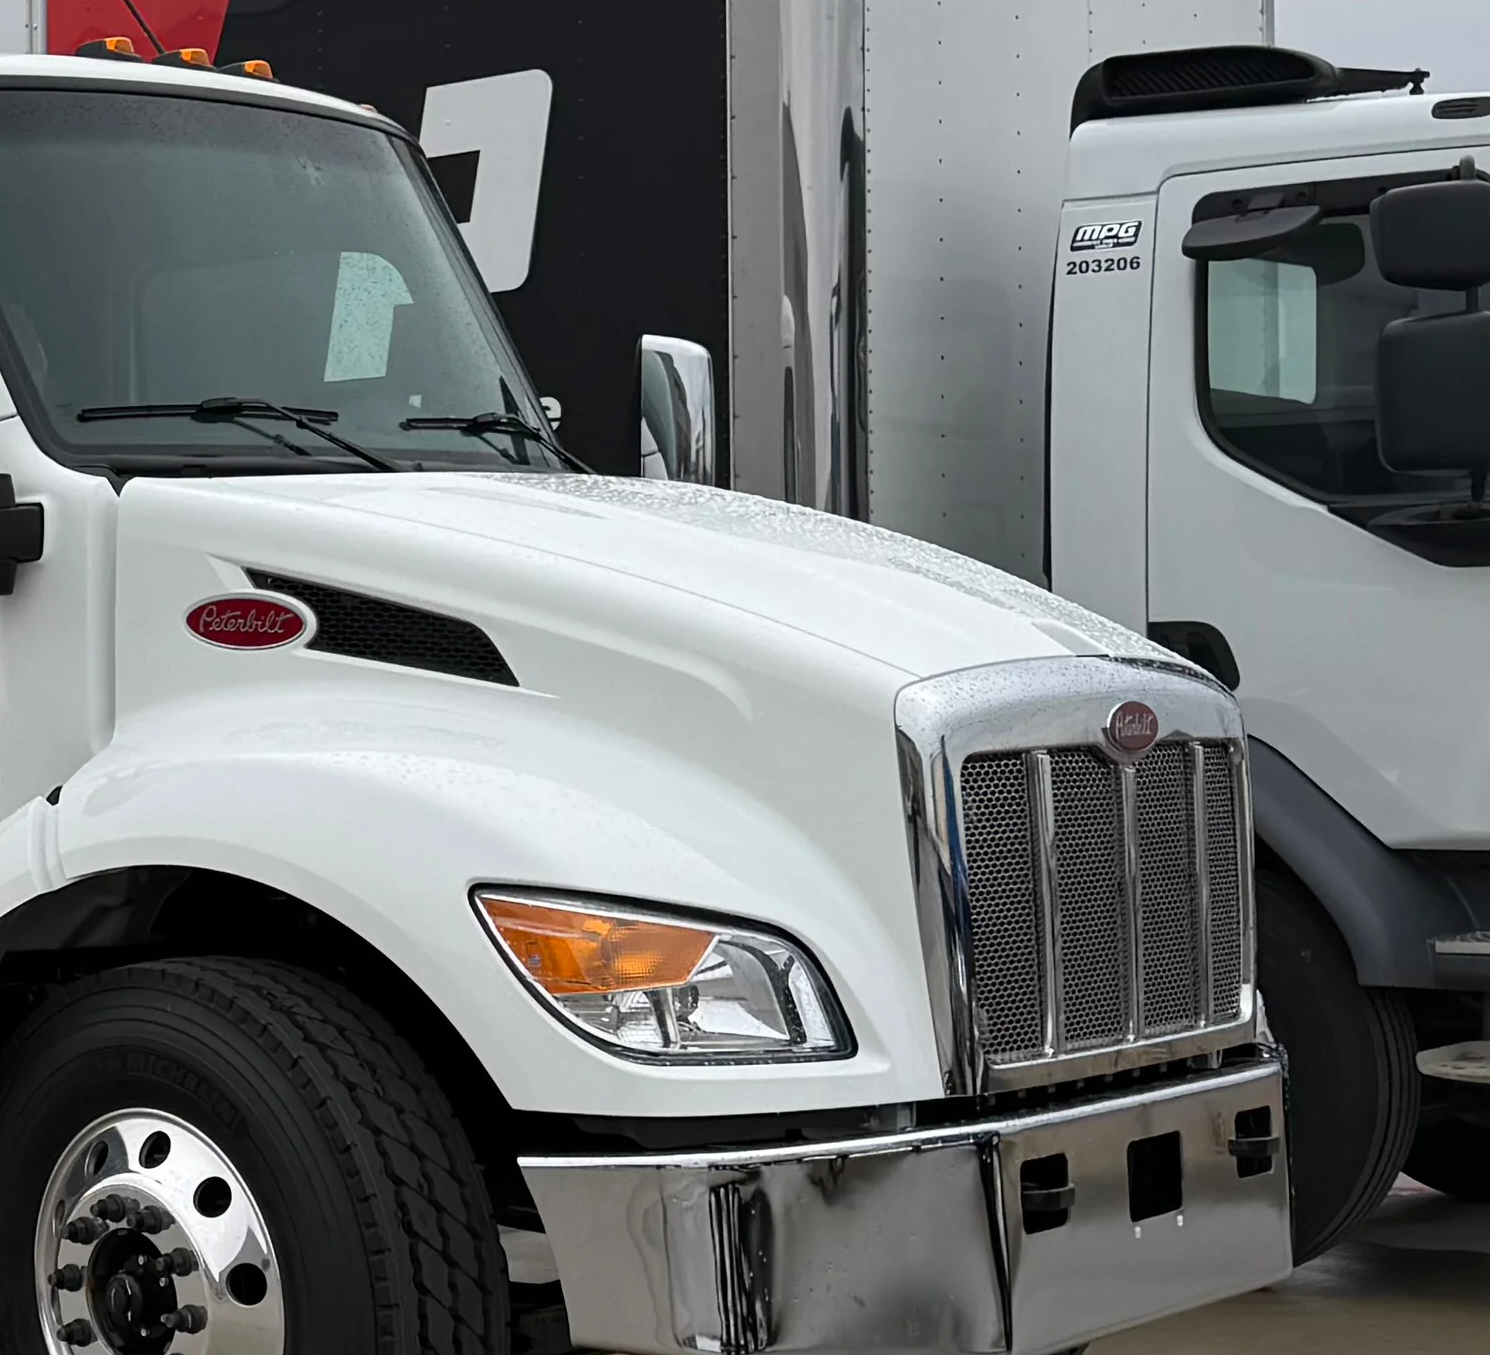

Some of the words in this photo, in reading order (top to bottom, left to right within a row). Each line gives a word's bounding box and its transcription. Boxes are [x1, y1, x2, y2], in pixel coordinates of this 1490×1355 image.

[1075, 221, 1139, 241] MPG
[1066, 256, 1141, 275] 203206
[199, 605, 294, 634] Peterbilt
